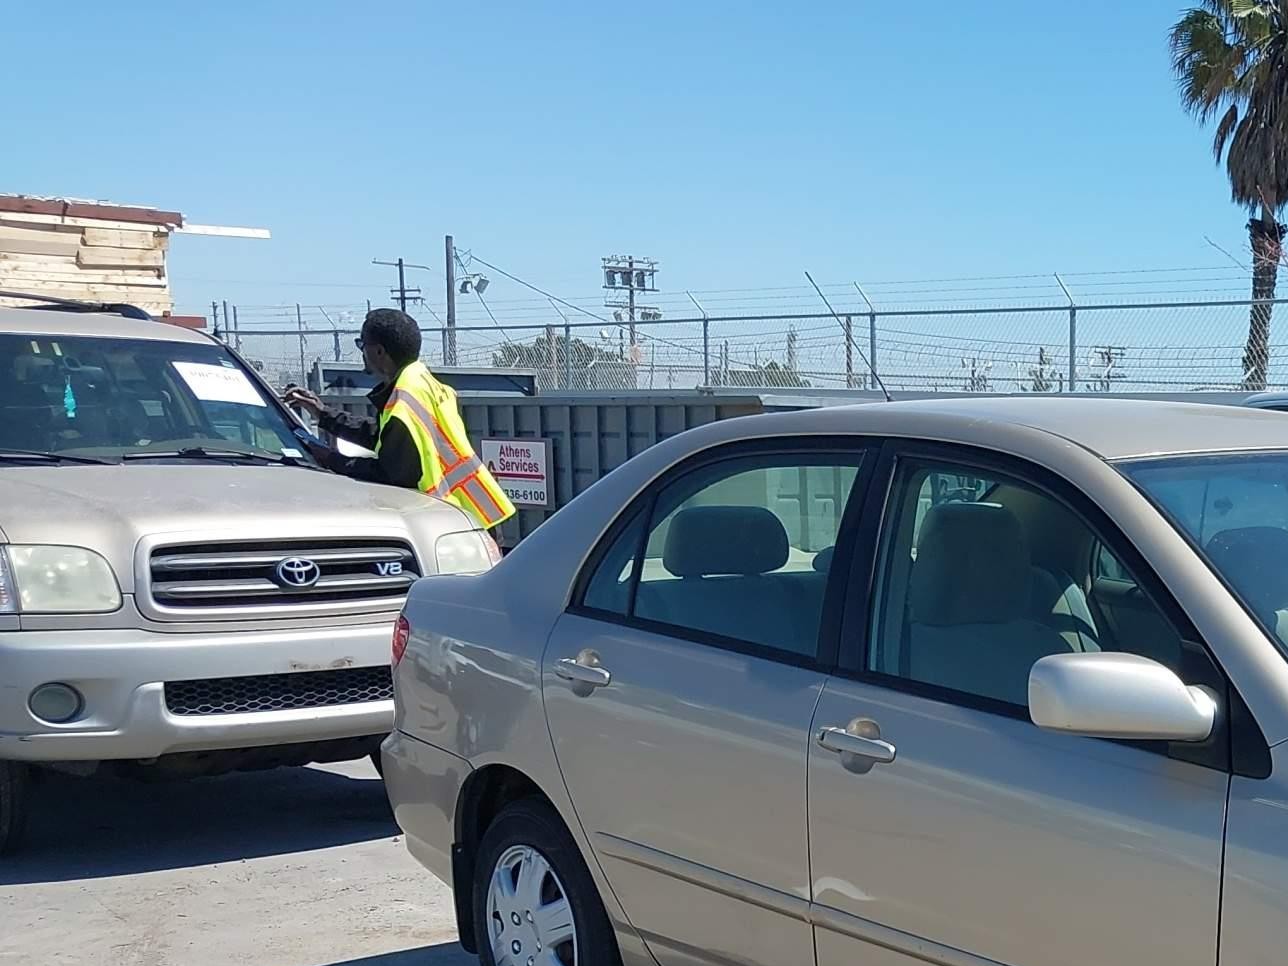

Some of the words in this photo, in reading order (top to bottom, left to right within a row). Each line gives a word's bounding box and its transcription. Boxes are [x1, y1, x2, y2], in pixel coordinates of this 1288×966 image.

[499, 444, 532, 459] Athens
[499, 458, 540, 473] Services
[376, 562, 403, 576] V8
